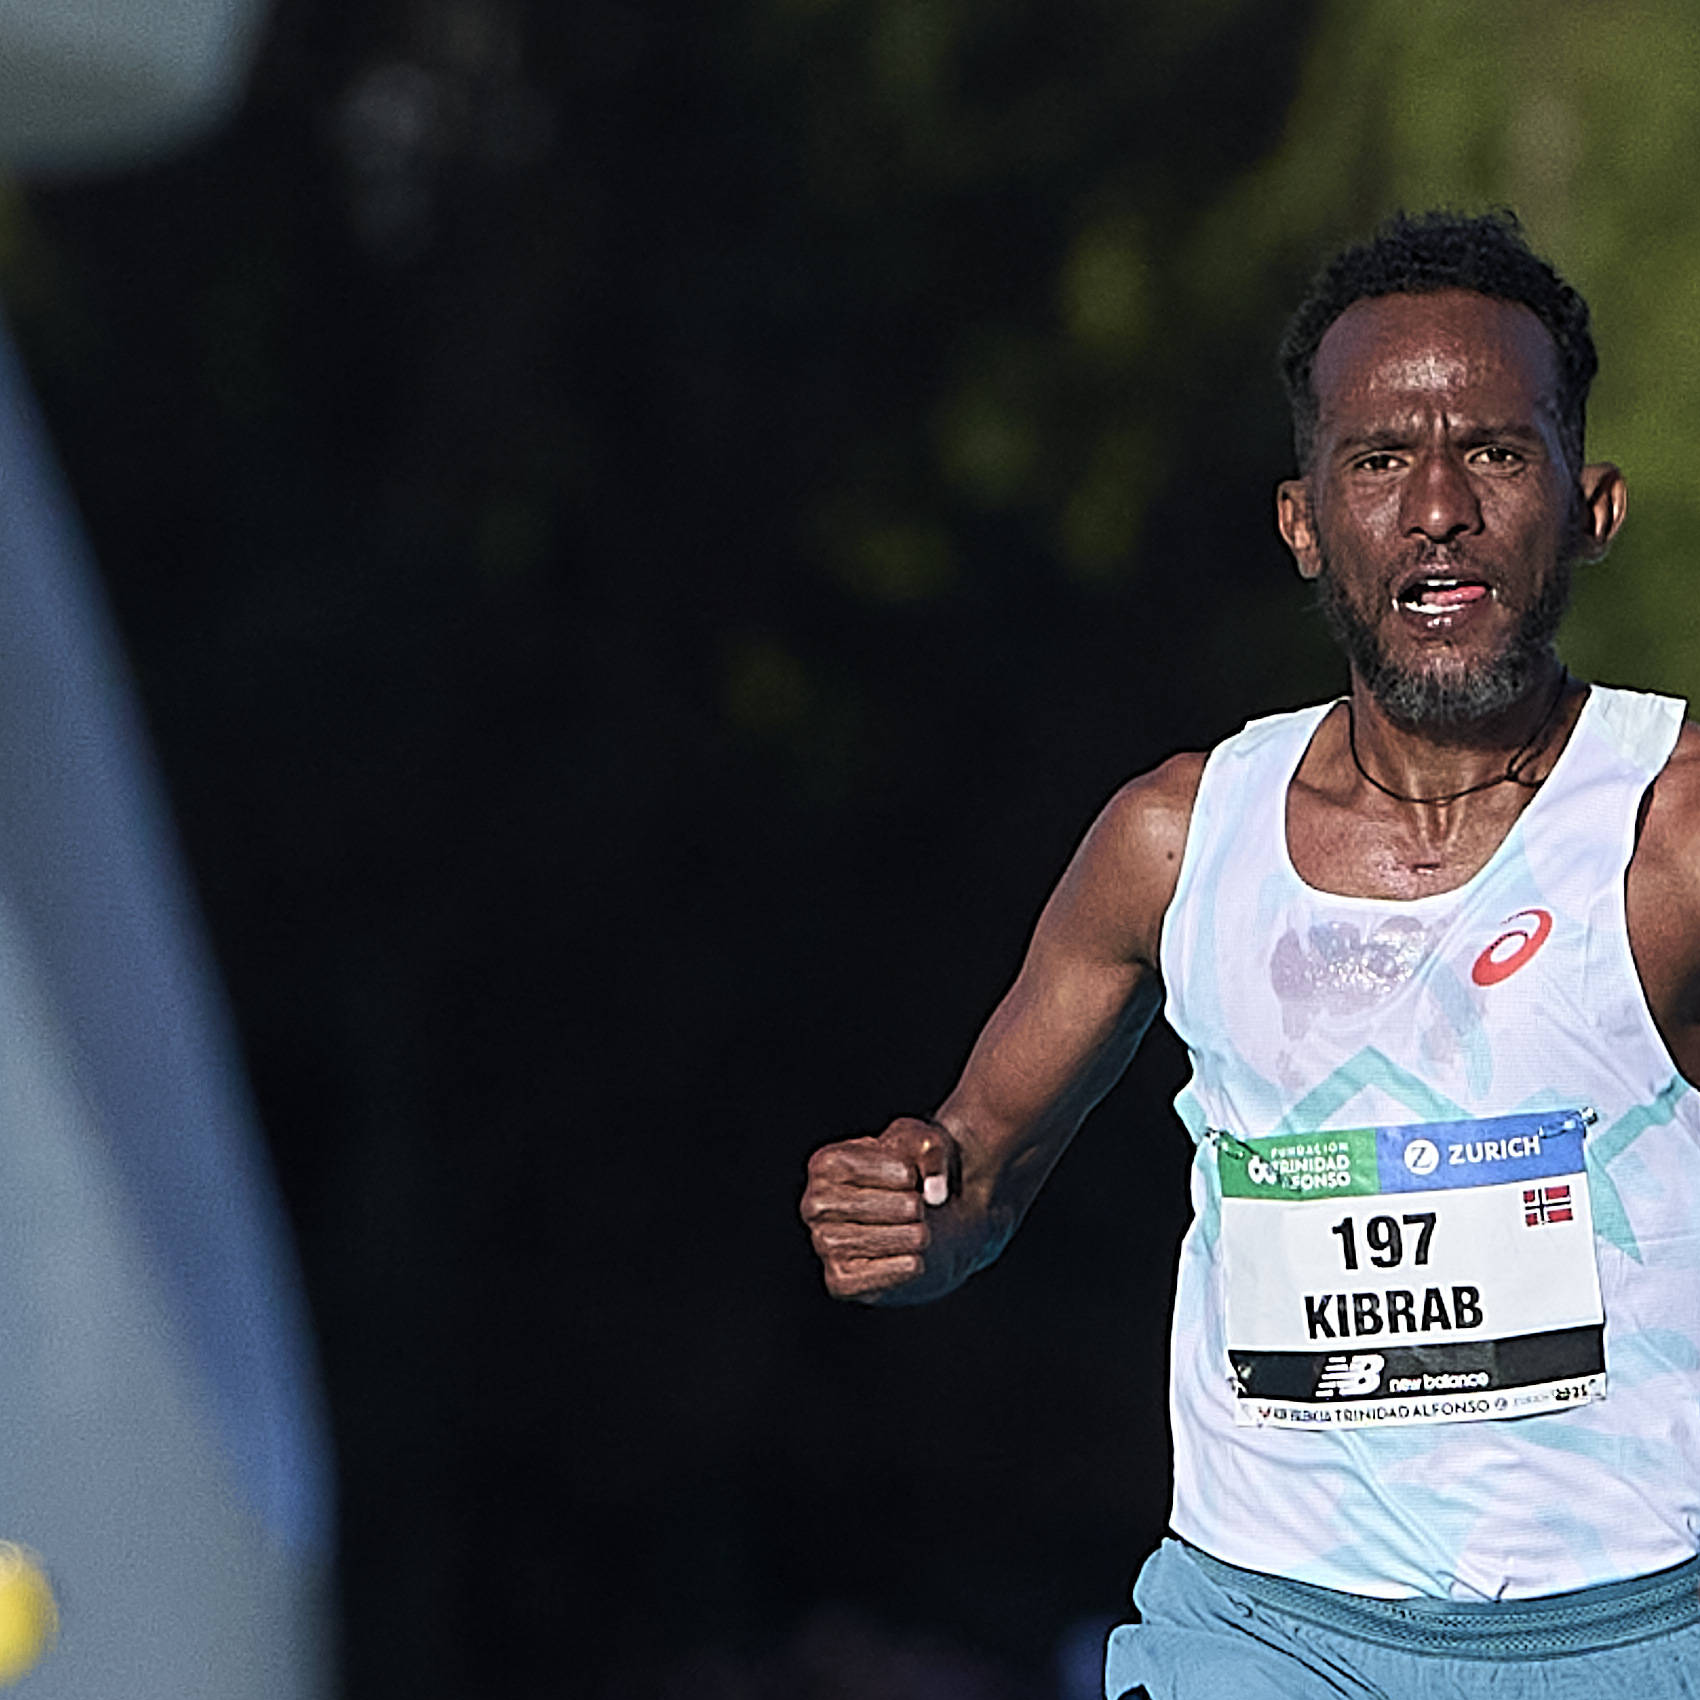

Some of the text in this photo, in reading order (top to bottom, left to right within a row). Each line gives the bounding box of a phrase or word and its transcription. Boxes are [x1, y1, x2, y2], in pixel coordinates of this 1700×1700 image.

[1448, 1134, 1541, 1165] ZURICH
[1271, 1154, 1350, 1174] TRINIDAD
[1331, 1212, 1437, 1270] 197
[1303, 1285, 1484, 1340] KIBRAB
[1389, 1372, 1489, 1393] new balance
[1335, 1405, 1410, 1422] TRINIDAD
[1413, 1400, 1490, 1419] ALFONSO
